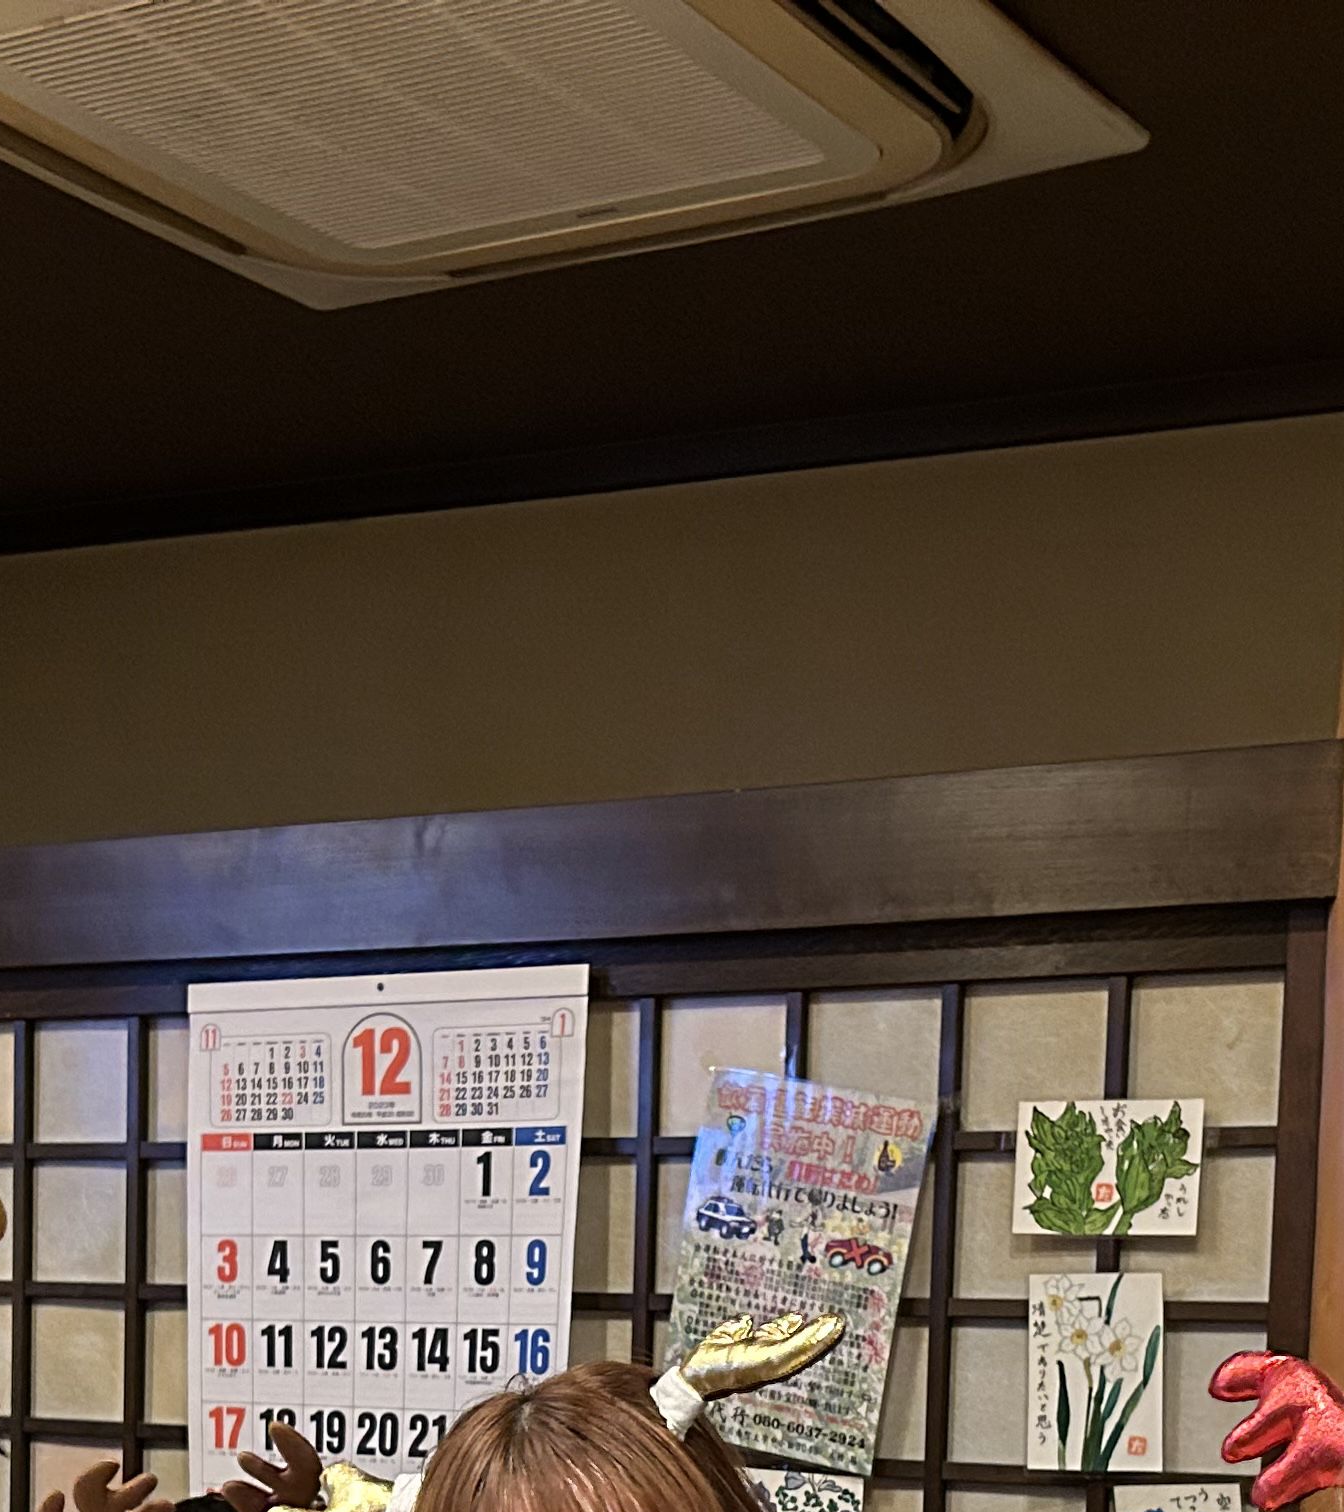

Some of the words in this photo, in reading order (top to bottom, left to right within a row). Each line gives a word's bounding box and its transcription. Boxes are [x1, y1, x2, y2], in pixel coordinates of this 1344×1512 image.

[205, 1028, 216, 1050] 11
[459, 1040, 463, 1052] 1
[475, 1039, 480, 1052] 2
[491, 1038, 497, 1051] 3
[507, 1038, 513, 1050] 4
[524, 1037, 530, 1049] 5
[540, 1036, 546, 1049] 6
[270, 1048, 274, 1058] 1
[284, 1047, 290, 1058] 2
[300, 1046, 305, 1058] 3
[315, 1046, 321, 1058] 4
[443, 1056, 448, 1068] 7
[475, 1055, 481, 1068] 9
[488, 1055, 500, 1067] 10
[504, 1054, 515, 1066] 11
[521, 1053, 532, 1066] 12
[538, 1052, 549, 1065] 13
[224, 1064, 229, 1075] 5
[238, 1063, 244, 1075] 6
[254, 1062, 259, 1075] 7
[269, 1062, 274, 1074] 8
[284, 1062, 290, 1074] 9
[297, 1062, 308, 1073] 10
[313, 1061, 323, 1072] 11
[353, 1027, 411, 1096] 12
[221, 1079, 231, 1091] 12
[236, 1078, 247, 1090] 13
[251, 1078, 262, 1089] 14
[266, 1078, 277, 1089] 15
[282, 1078, 293, 1089] 16
[297, 1077, 308, 1089] 17
[313, 1076, 324, 1088] 18
[440, 1072, 451, 1084] 14
[456, 1072, 467, 1084] 15
[472, 1071, 483, 1084] 16
[488, 1070, 500, 1083] 17
[504, 1070, 515, 1082] 18
[520, 1069, 532, 1082] 19
[536, 1068, 548, 1081] 20
[236, 1094, 247, 1105] 20
[251, 1094, 261, 1105] 21
[266, 1093, 277, 1105] 22
[282, 1092, 293, 1104] 23
[297, 1092, 308, 1104] 24
[313, 1092, 324, 1104] 25
[440, 1088, 450, 1101] 21
[455, 1088, 467, 1100] 22
[471, 1087, 483, 1099] 23
[487, 1086, 498, 1099] 24
[503, 1086, 515, 1098] 25
[520, 1085, 531, 1098] 26
[536, 1084, 548, 1097] 27
[221, 1109, 232, 1121] 26
[236, 1109, 247, 1120] 27
[251, 1108, 262, 1120] 28
[266, 1108, 277, 1120] 29
[282, 1108, 293, 1120] 30
[440, 1104, 451, 1116] 28
[455, 1103, 467, 1116] 29
[471, 1102, 483, 1115] 30
[488, 1102, 498, 1115] 31
[267, 1166, 288, 1188] 27
[477, 1152, 491, 1196] 1
[529, 1150, 551, 1196] 2
[217, 1239, 238, 1283] 3
[268, 1240, 290, 1283] 4
[320, 1240, 340, 1283] 5
[371, 1240, 391, 1284] 6
[423, 1240, 443, 1284] 7
[475, 1240, 495, 1285] 8
[527, 1239, 546, 1286] 9
[208, 1323, 246, 1367] 10
[261, 1325, 292, 1367] 11
[311, 1326, 347, 1368] 12
[362, 1326, 398, 1370] 13
[412, 1328, 449, 1372] 14
[464, 1328, 499, 1373] 15
[515, 1328, 550, 1375] 16
[209, 1407, 246, 1448] 17
[310, 1410, 346, 1454] 19
[357, 1412, 399, 1457] 20
[408, 1413, 447, 1457] 21
[753, 1413, 866, 1449] 080-6037-2924
